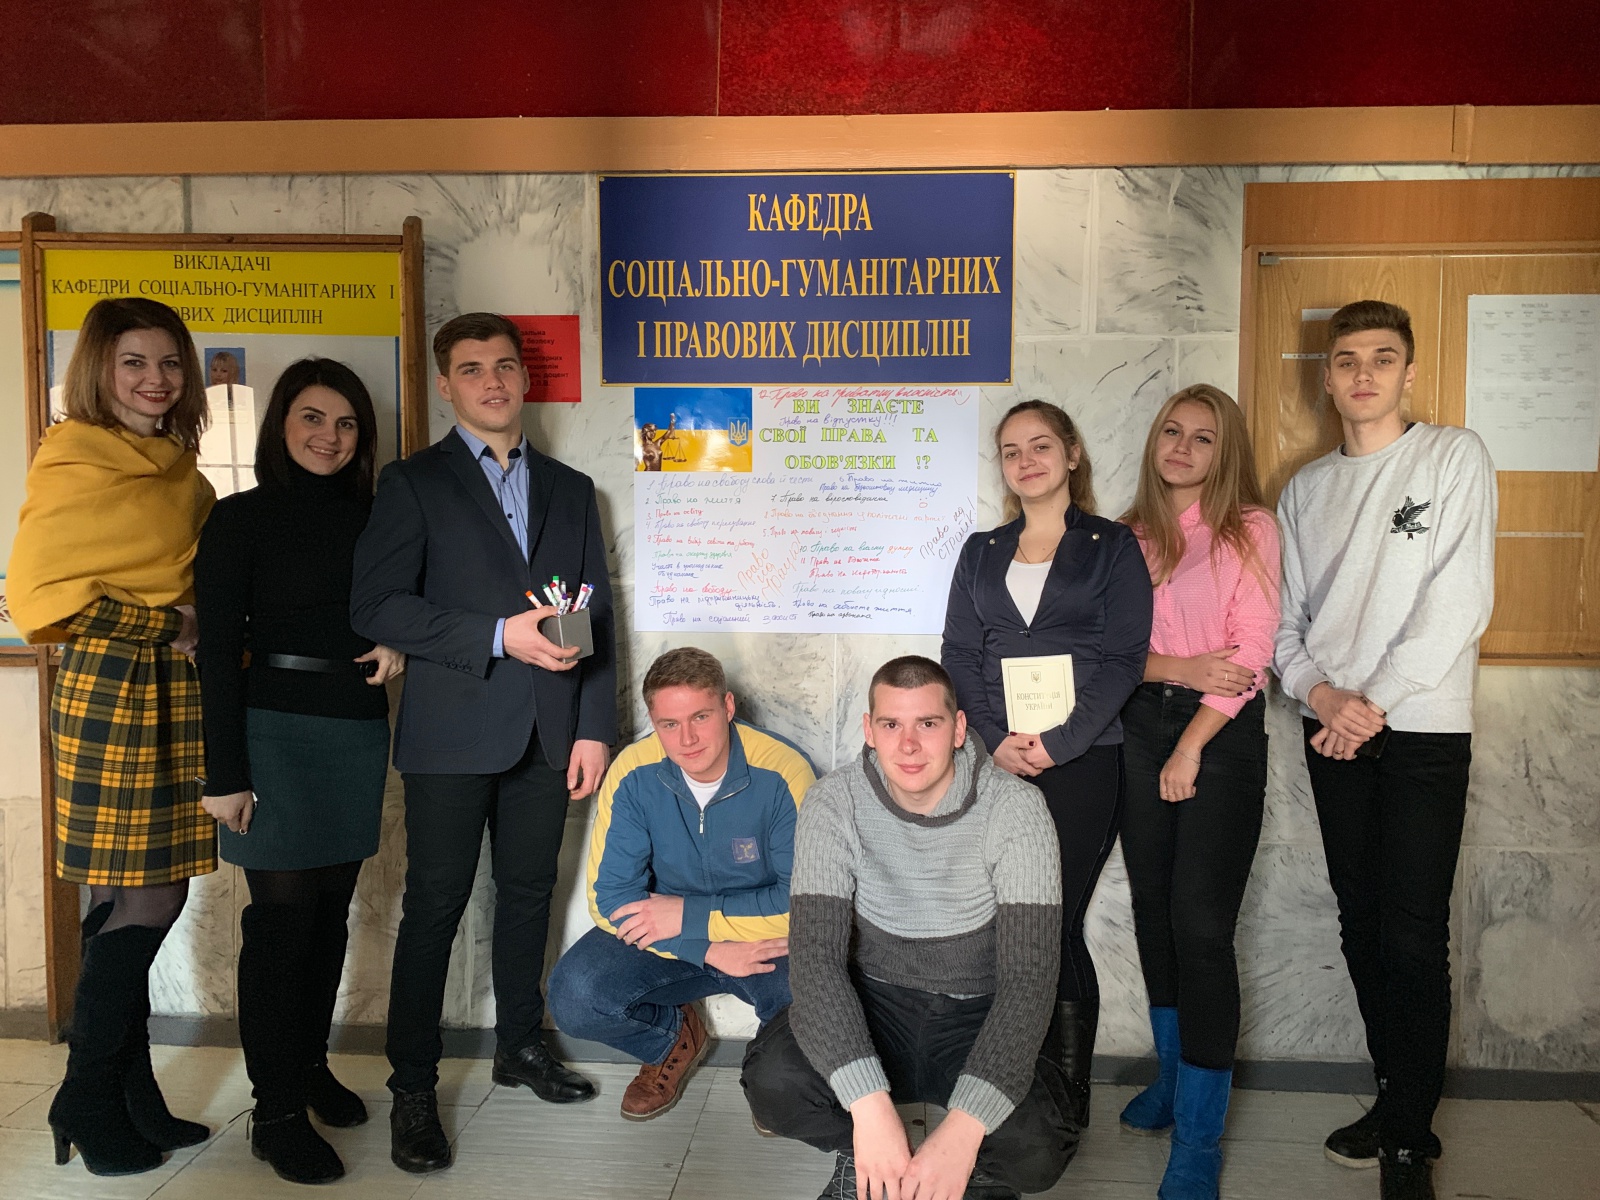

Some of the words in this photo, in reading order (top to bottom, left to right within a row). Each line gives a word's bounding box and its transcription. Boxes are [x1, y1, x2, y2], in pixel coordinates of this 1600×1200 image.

[747, 193, 874, 240] КАФЕДРА
[173, 253, 271, 272] ВИКЛАДАЧІ
[52, 279, 130, 296] КАФЕДРИ
[139, 280, 377, 300] СОЦІАЛЬНО-ГУМАНІТАРНИХ
[389, 284, 395, 300] І
[608, 256, 1002, 306] СОЦІАЛЬНО-ГУМАНІТАРНИХ
[222, 308, 323, 325] ДИСЦИПЛІН
[636, 321, 647, 358] І
[653, 321, 796, 359] ПРАВОВИХ
[802, 319, 971, 367] ДИСЦИПЛІН
[813, 388, 829, 398] на
[793, 398, 821, 414] ВИ
[847, 397, 925, 415] ЗНАЄТЕ
[759, 426, 807, 443] СВОЇ
[821, 427, 888, 443] ПРАВА
[912, 427, 939, 443] ТА
[784, 455, 897, 470] ОБОВ'ЯЗКИ
[916, 455, 932, 470] !?
